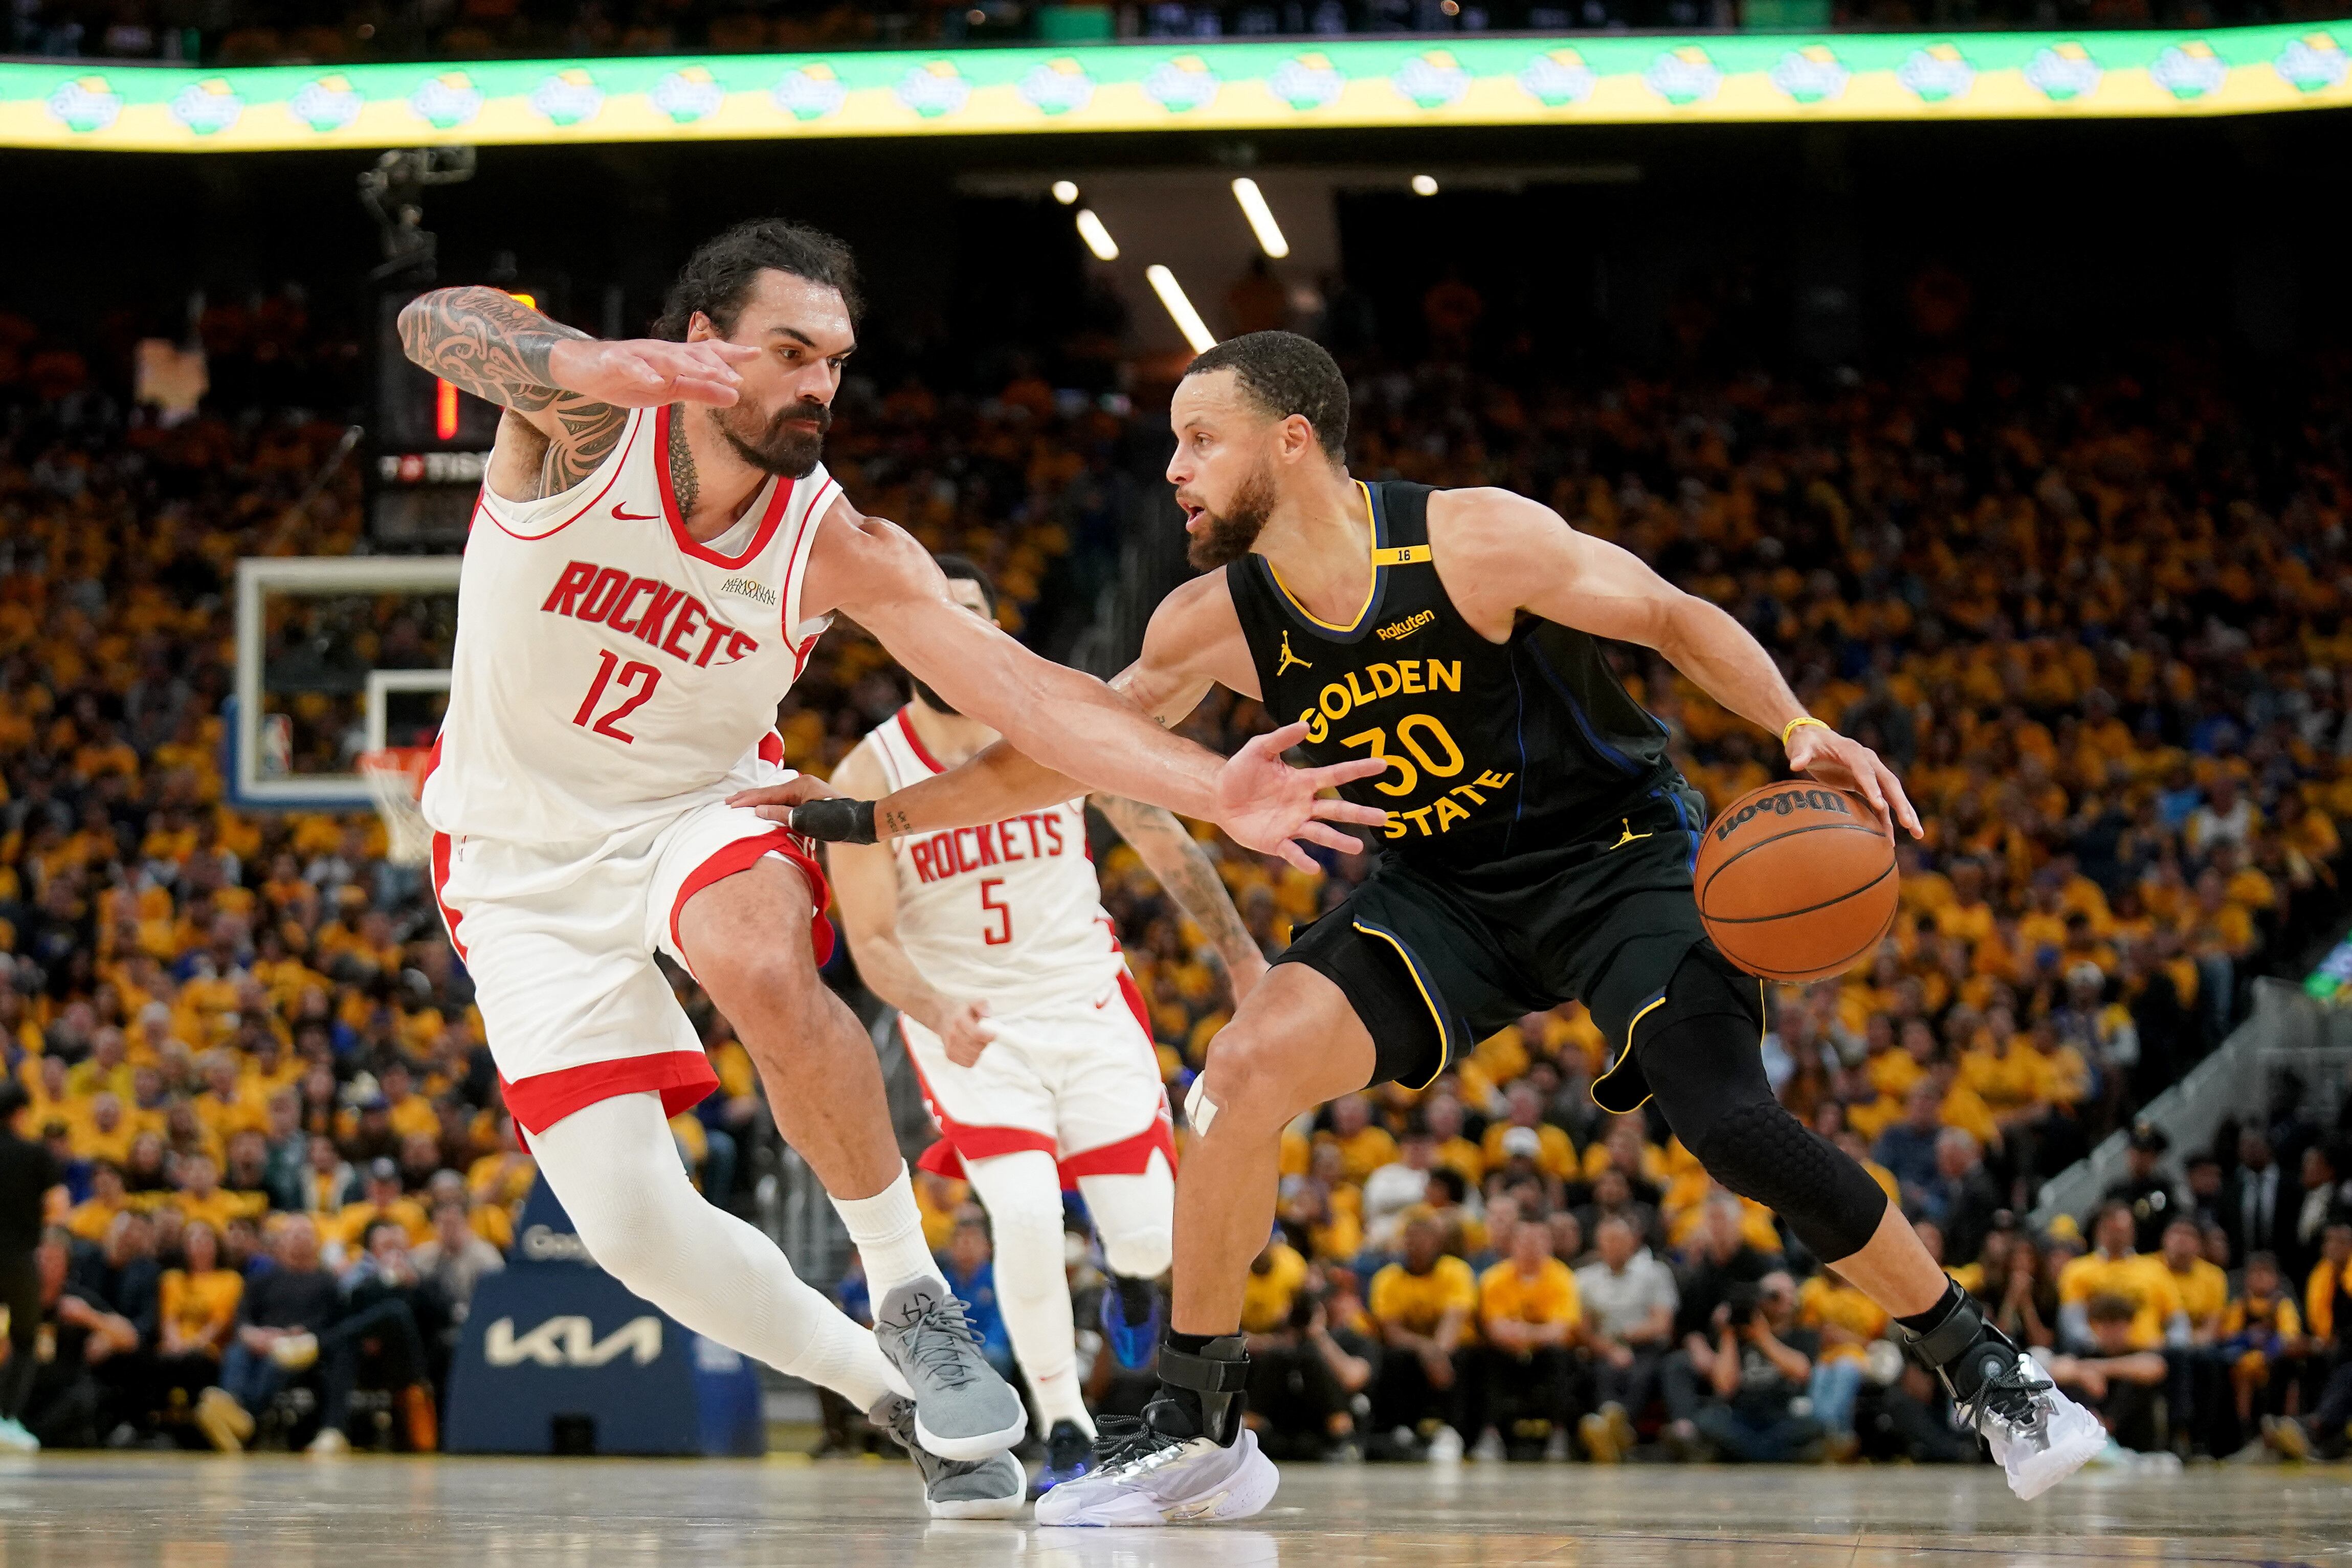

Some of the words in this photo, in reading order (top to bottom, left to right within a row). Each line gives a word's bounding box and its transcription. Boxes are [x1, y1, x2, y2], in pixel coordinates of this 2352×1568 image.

[724, 577, 776, 599] MEMORIAL
[1398, 550, 1411, 562] 16
[540, 559, 760, 669] ROCKETS
[721, 583, 776, 606] HERMANN
[1376, 609, 1435, 641] Rakuten
[572, 648, 662, 745] 12
[1298, 659, 1462, 744] GOLDEN
[1340, 713, 1465, 797] 30
[1384, 769, 1515, 839] STATE
[1715, 789, 1851, 841] Wilson
[910, 812, 1064, 884] ROCKETS
[981, 876, 1012, 946] 5
